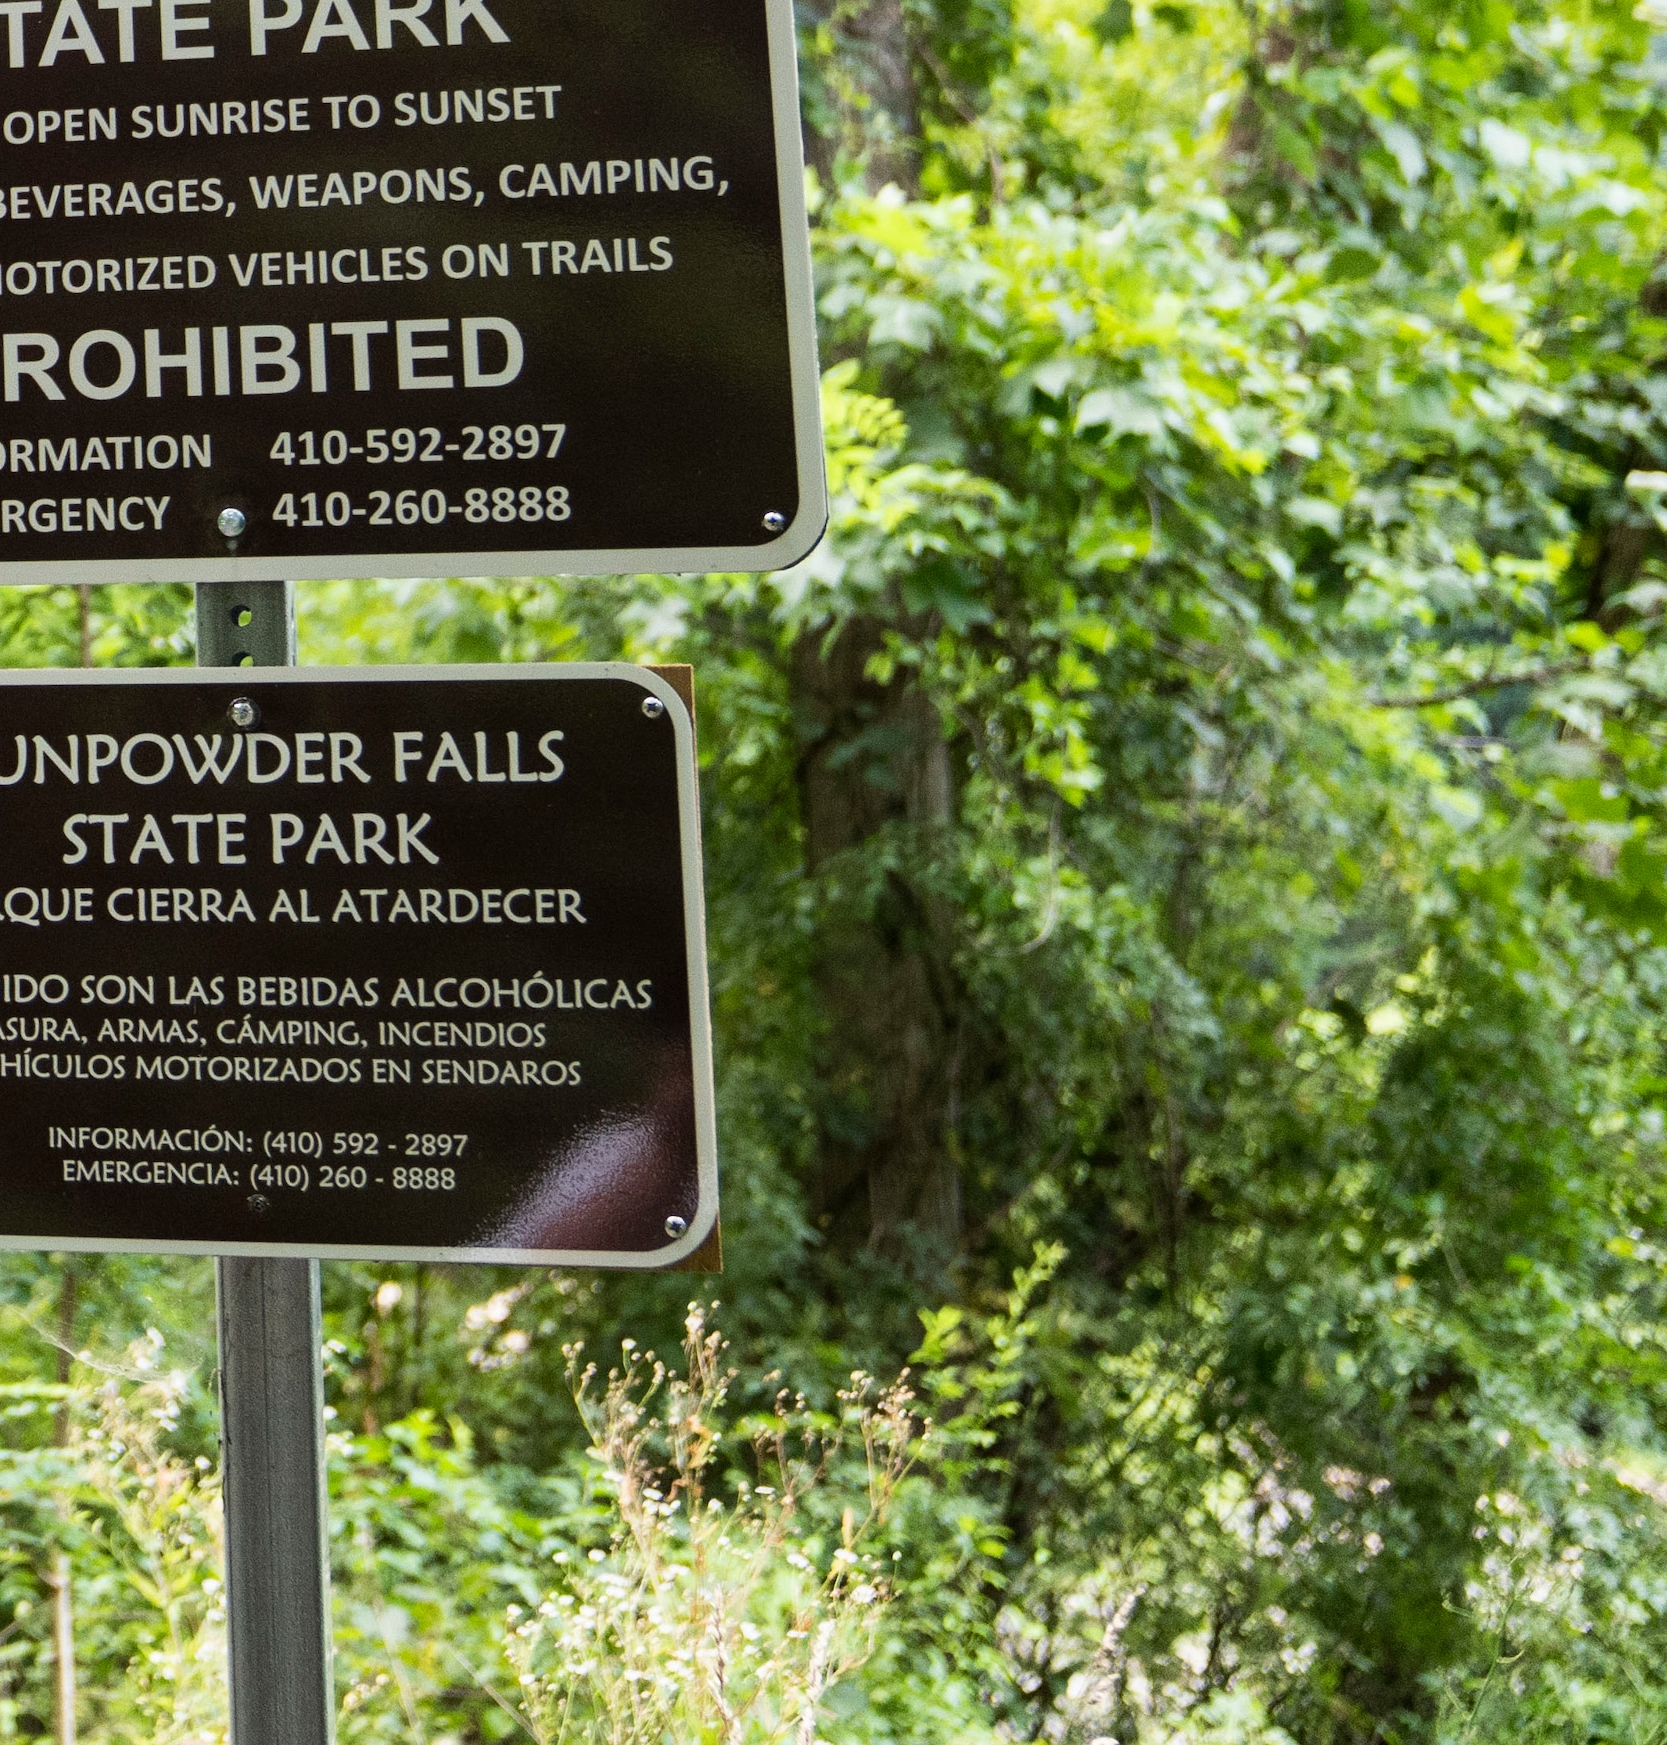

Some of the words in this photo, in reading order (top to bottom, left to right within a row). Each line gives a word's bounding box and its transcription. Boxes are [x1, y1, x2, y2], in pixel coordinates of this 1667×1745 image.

[3, 107, 117, 145] OPEN
[131, 97, 311, 139] SUNRISE
[321, 94, 381, 130] TO
[394, 85, 562, 127] SUNSET
[248, 166, 485, 210] WEAPONS,
[499, 155, 729, 199] CAMPING,
[228, 245, 429, 287] VEHICLES
[441, 242, 509, 280] ON
[521, 235, 674, 276] TRAILS
[269, 423, 566, 466] 410-592-2897
[272, 485, 571, 527] 410-260-8888
[393, 730, 565, 783] FALLS
[62, 812, 247, 865] STATE
[269, 812, 440, 865] PARK
[106, 887, 257, 923] CIERRA
[268, 888, 321, 923] AL
[332, 888, 587, 924] ATARDECER
[80, 974, 155, 1005] SON
[168, 975, 225, 1006] LAS
[237, 976, 379, 1007] BEBIDAS
[390, 970, 652, 1009] ALCOHÓLICAS
[97, 1018, 207, 1046] ARMAS,
[216, 1013, 368, 1048] CÁMPING,
[378, 1021, 546, 1048] INCENDIOS
[135, 1055, 362, 1083] MOTORIZADOS
[372, 1058, 411, 1083] EN
[422, 1059, 581, 1086] SENDAROS
[49, 1124, 253, 1153] INFORMACIÓN:
[263, 1130, 323, 1159] (410)
[333, 1132, 379, 1155] 592
[405, 1133, 468, 1157] 2897
[62, 1159, 239, 1186] EMERGENCIA:
[250, 1163, 309, 1192] (410)
[319, 1165, 367, 1189] 260
[392, 1166, 456, 1190] 8888
